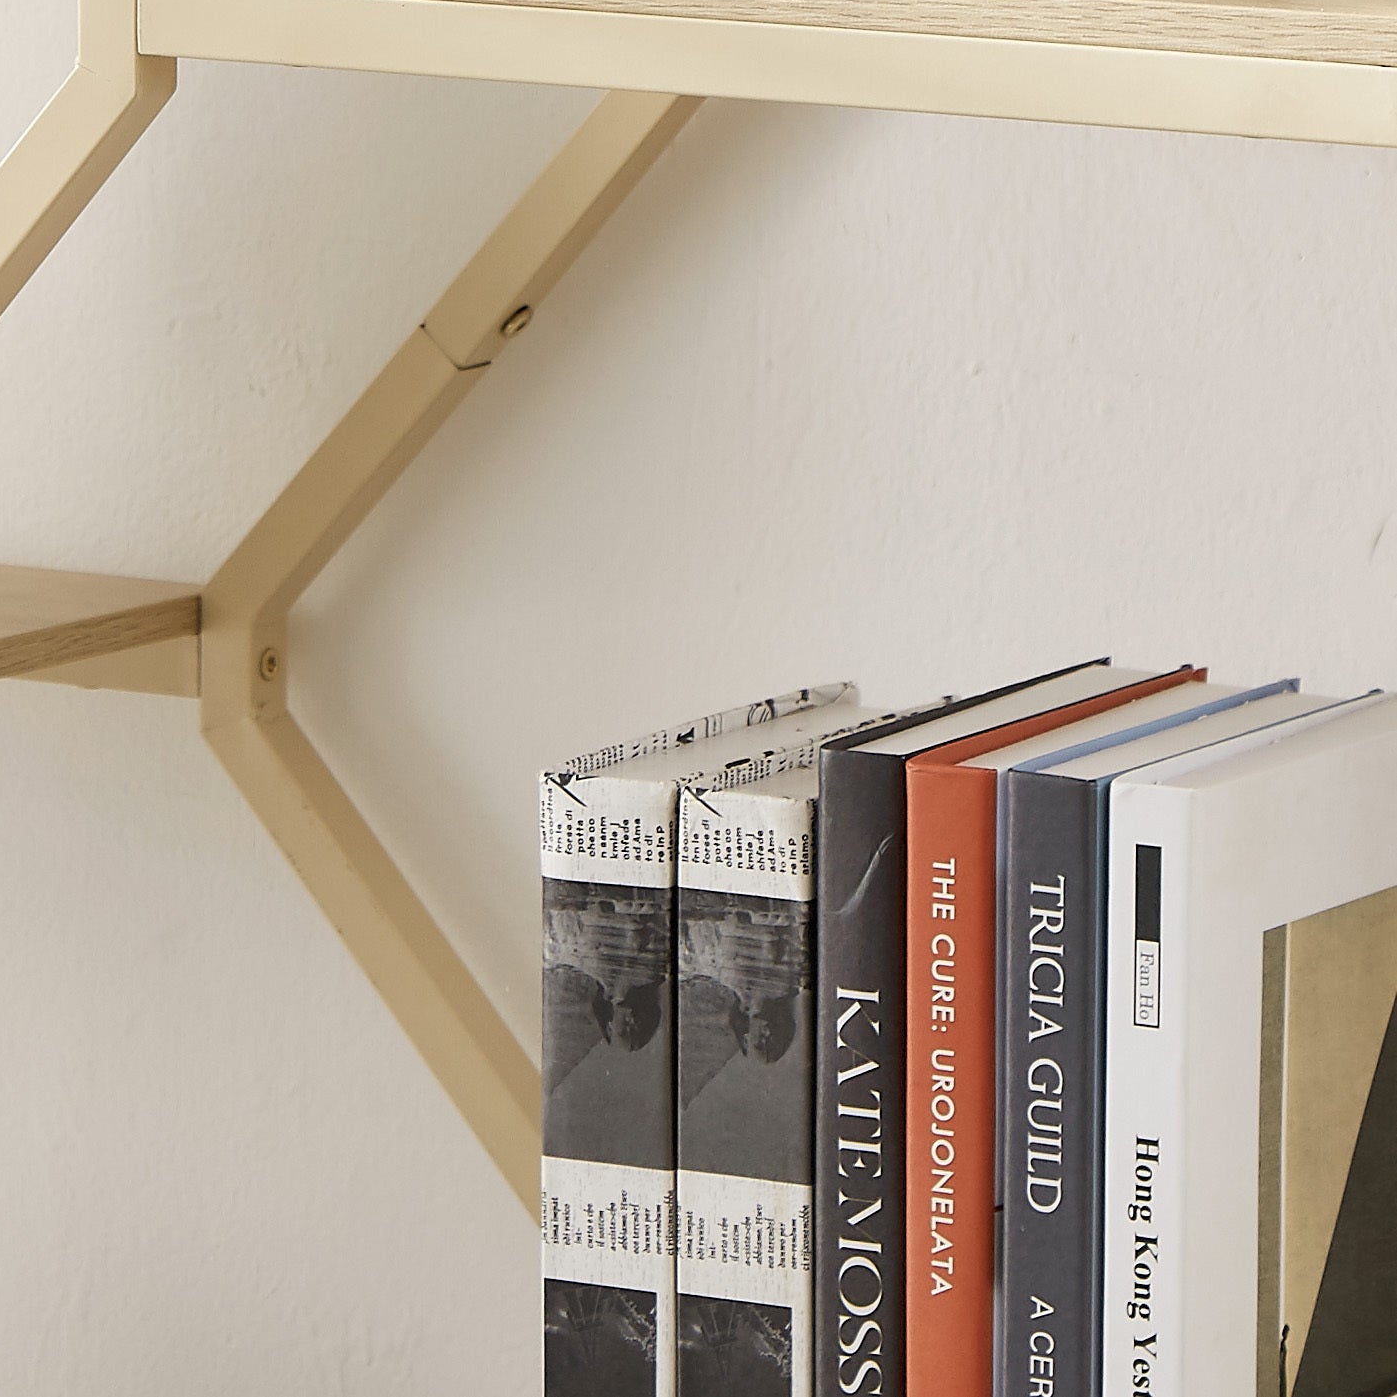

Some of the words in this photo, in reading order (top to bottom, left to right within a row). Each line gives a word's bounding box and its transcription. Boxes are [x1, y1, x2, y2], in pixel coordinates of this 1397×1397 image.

[931, 857, 956, 920] THE
[930, 933, 956, 1033] CURE:
[1027, 874, 1065, 1043] TRICIA
[1139, 952, 1155, 986] Fan
[1139, 995, 1154, 1021] Ho
[836, 986, 883, 1178] KATE
[929, 1049, 956, 1295] UROJONELATA
[1026, 1058, 1063, 1214] GUILD
[1127, 1134, 1160, 1224] Hong
[837, 1188, 883, 1395] MOSS
[1029, 1296, 1055, 1320] A
[1126, 1234, 1159, 1322] Kong
